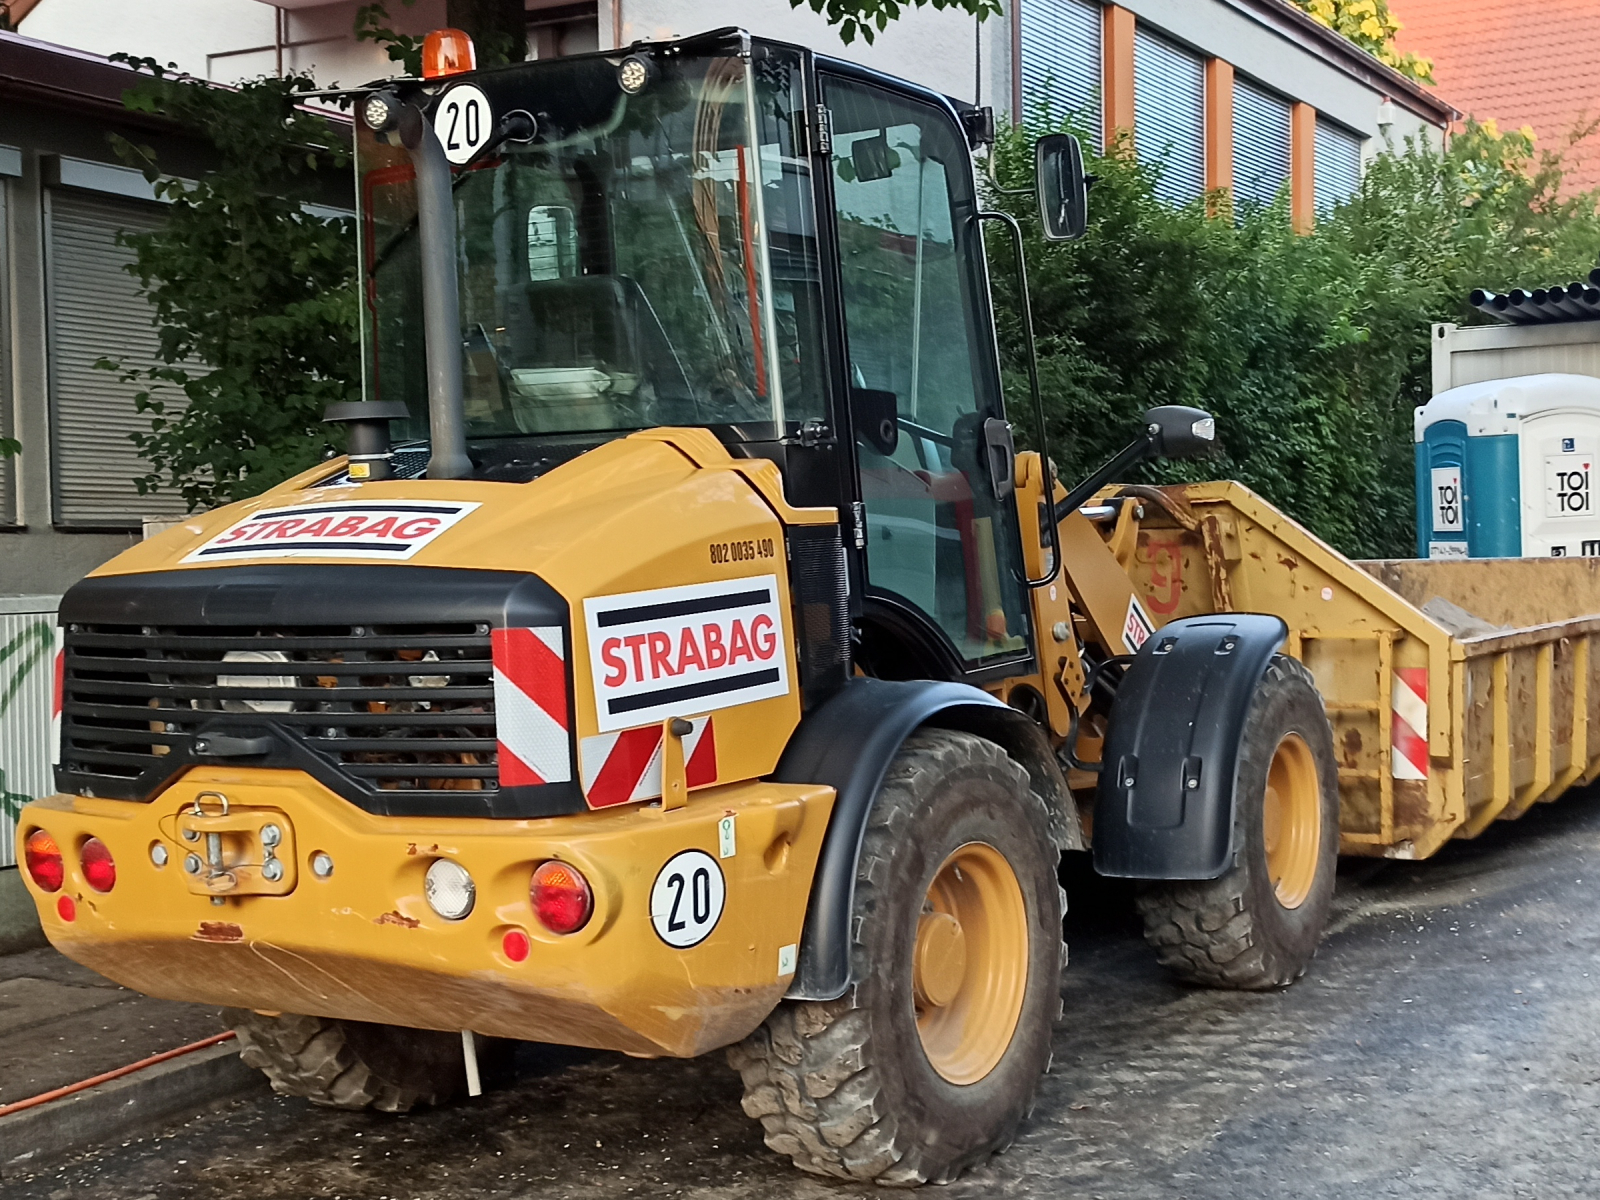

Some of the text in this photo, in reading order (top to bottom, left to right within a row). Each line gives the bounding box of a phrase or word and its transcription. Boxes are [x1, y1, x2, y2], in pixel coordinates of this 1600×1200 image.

[446, 99, 480, 151] 20
[1439, 505, 1460, 525] TOI
[1556, 491, 1590, 512] TOI
[214, 516, 443, 544] STRABAG
[709, 543, 730, 564] 802
[730, 540, 756, 562] 0035
[756, 537, 775, 559] 490
[601, 613, 777, 688] STRABAG
[666, 867, 711, 933] 20
